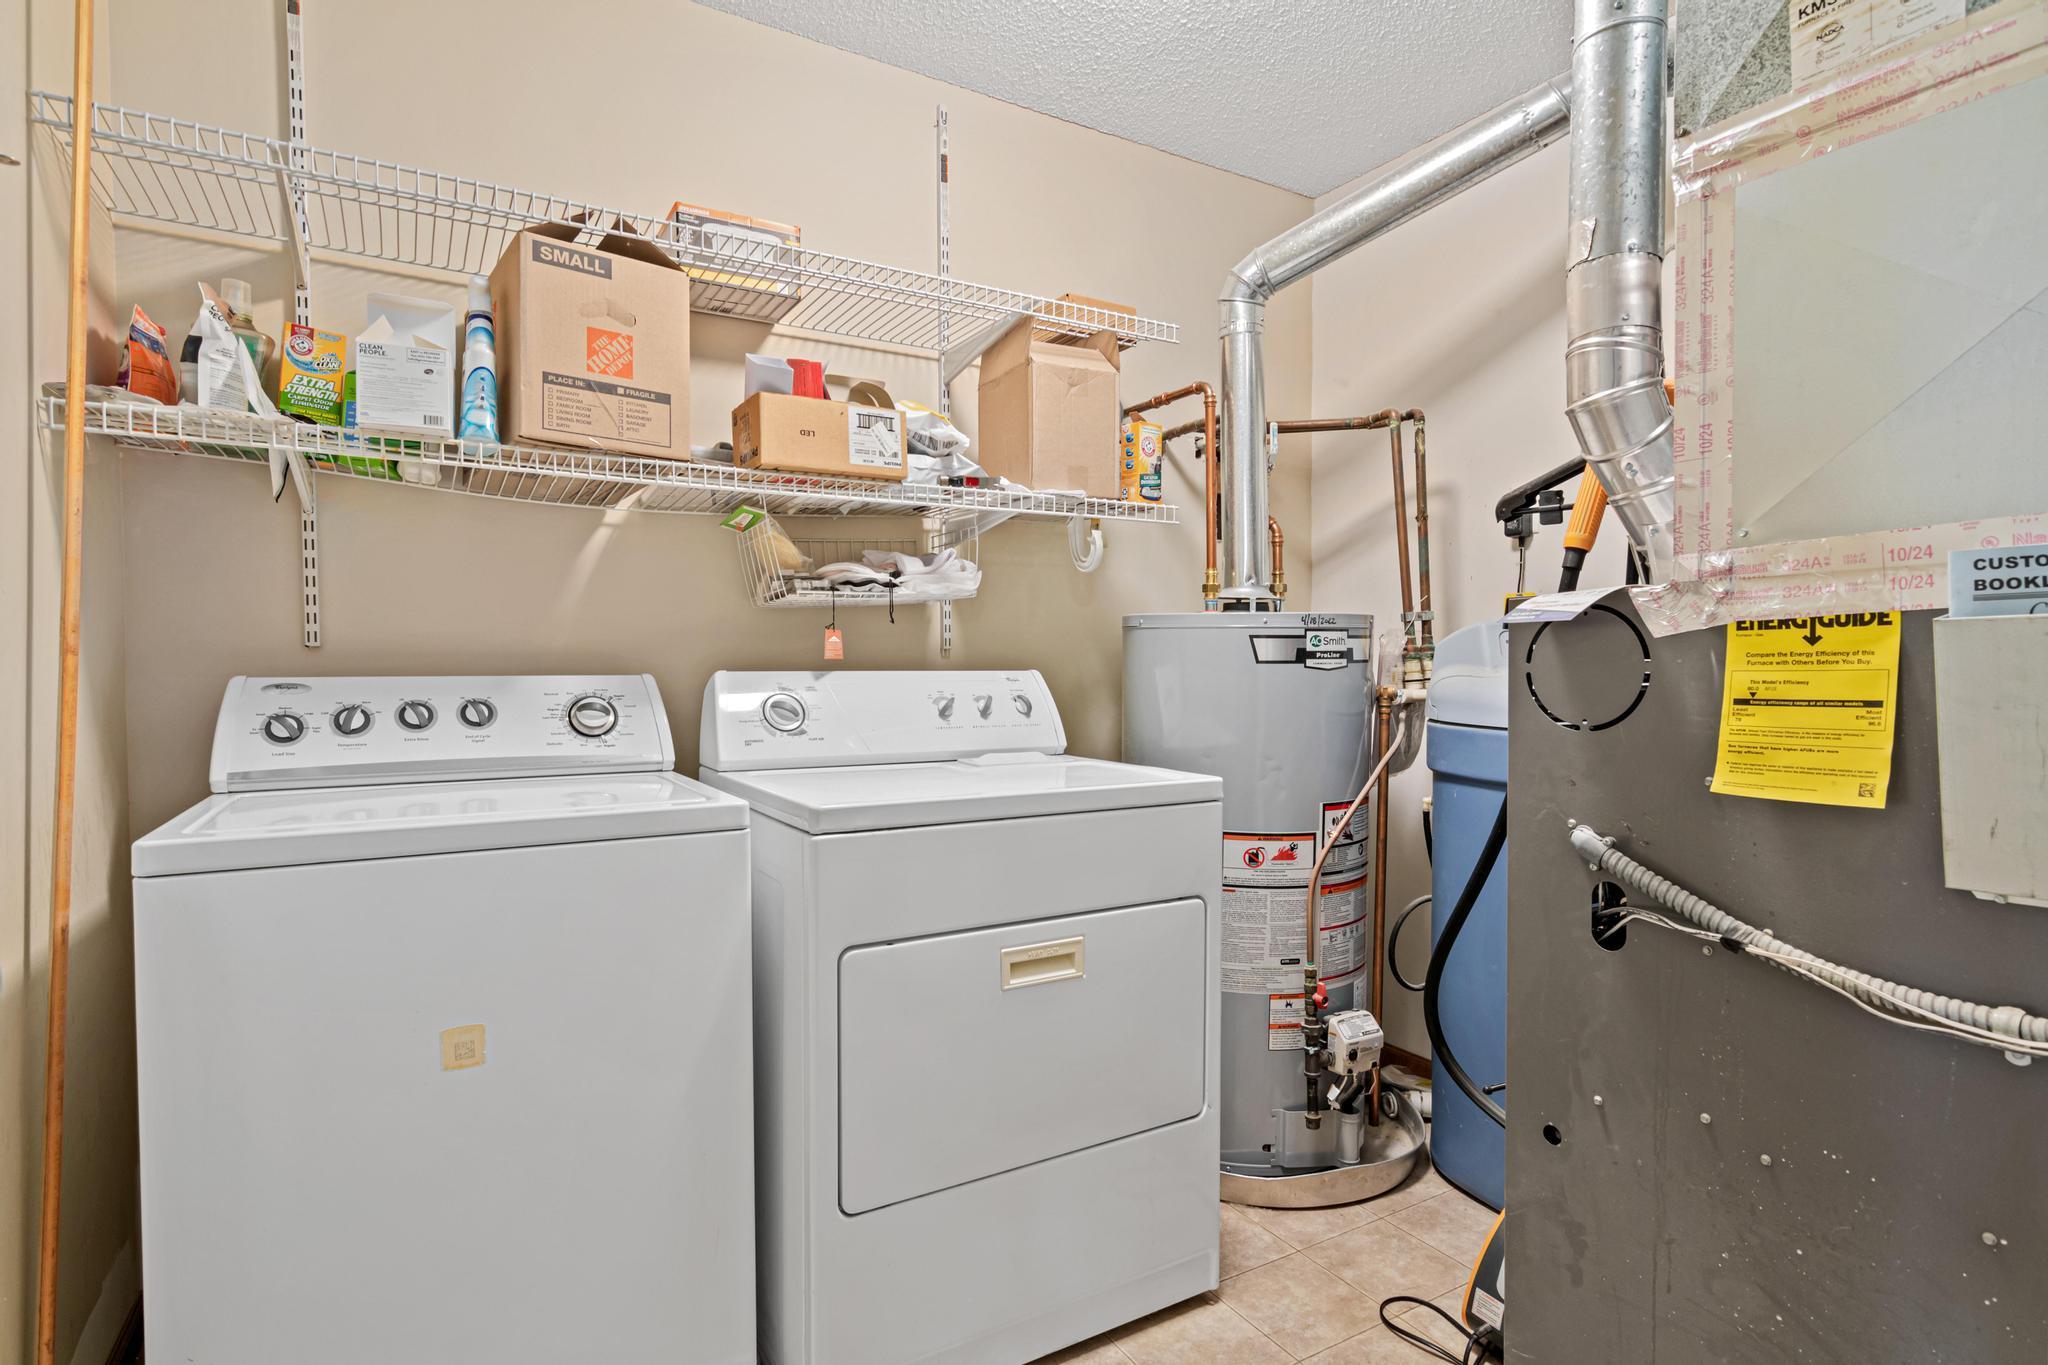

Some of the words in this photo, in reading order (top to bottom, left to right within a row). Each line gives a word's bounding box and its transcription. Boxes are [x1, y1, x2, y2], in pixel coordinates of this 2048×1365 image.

[1798, 12, 1829, 28] FURNACE
[1815, 24, 1845, 42] NADCA
[1931, 30, 1983, 59] 324A
[540, 246, 605, 275] SMALL
[1699, 269, 1714, 304] 324A
[359, 343, 383, 351] CLEAN
[592, 335, 610, 350] THE
[587, 334, 633, 372] HOME
[605, 352, 633, 375] DEPOT
[291, 374, 335, 391] EXTRA
[548, 375, 574, 385] PLACE
[284, 383, 339, 402] STRENGTH
[287, 393, 312, 402] CARPET
[313, 397, 334, 406] ODOR
[556, 388, 581, 397] PRIMARY
[556, 396, 584, 404] BEDROOM
[626, 390, 656, 400] FRAGILE
[291, 399, 330, 410] ELIMINATOR
[626, 414, 652, 422] BASEMENT
[800, 430, 816, 438] LED
[1698, 423, 1713, 455] 10/24
[1673, 428, 1686, 459] 10/24
[1888, 544, 1934, 562] 10/24
[1973, 554, 2048, 571] CUSTO
[1782, 582, 1824, 600] 324A
[1889, 574, 1935, 591] 10/24
[1301, 614, 1337, 627] 4/18/2022
[1736, 611, 1893, 632] ENERGGUIDE
[1323, 636, 1346, 646] Smith
[1790, 651, 1814, 659] Energy
[1816, 650, 1850, 658] Efficiency
